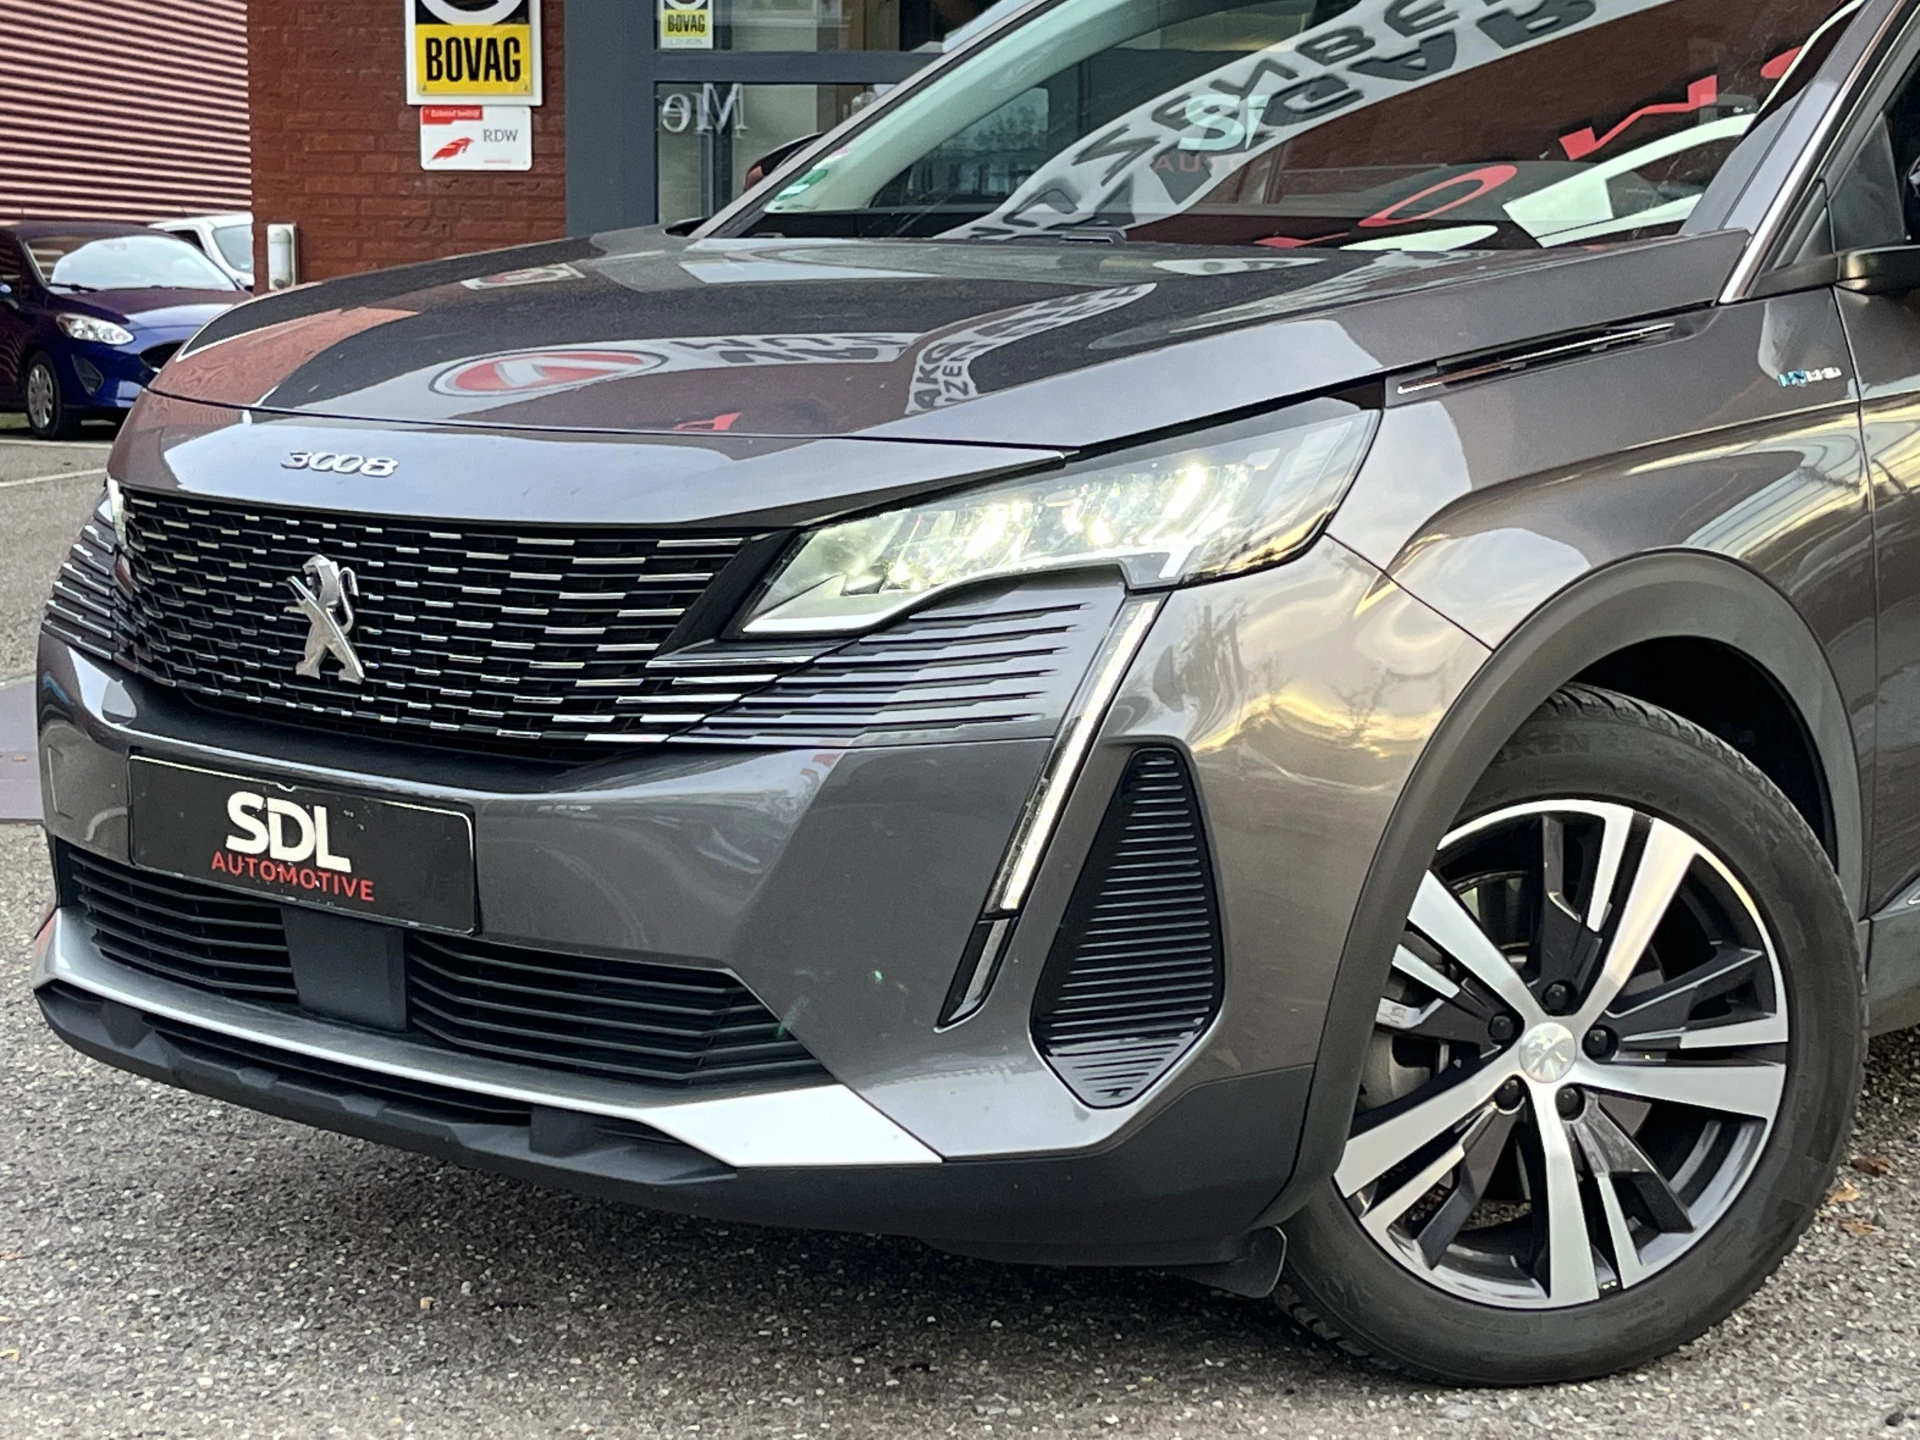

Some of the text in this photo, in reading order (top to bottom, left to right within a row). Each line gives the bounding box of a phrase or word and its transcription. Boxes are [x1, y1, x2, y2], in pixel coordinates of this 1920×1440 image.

[667, 13, 706, 33] BOVAG
[425, 36, 521, 82] BOVAG
[483, 129, 519, 143] RDW
[280, 450, 399, 478] 3008
[225, 791, 352, 873] SDL
[211, 850, 375, 902] AUTOMOTIVE
